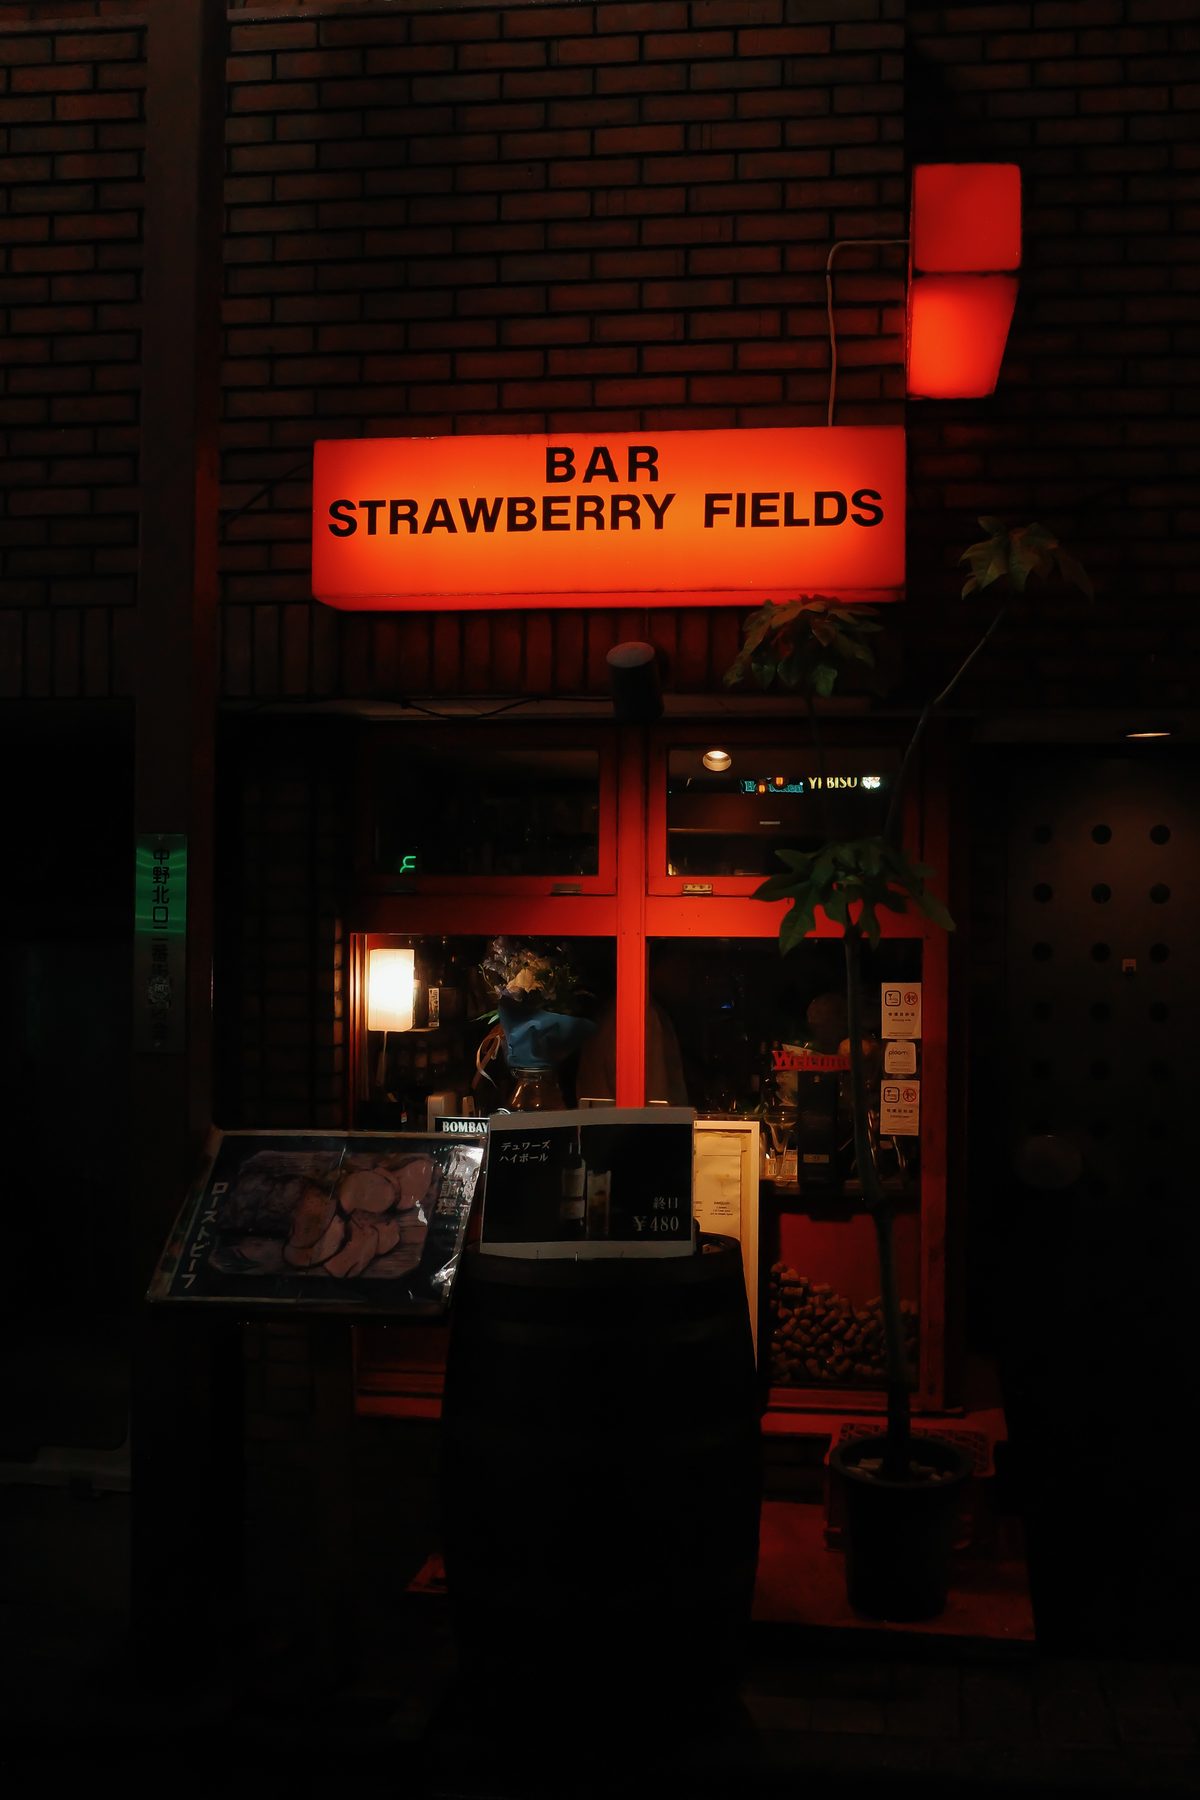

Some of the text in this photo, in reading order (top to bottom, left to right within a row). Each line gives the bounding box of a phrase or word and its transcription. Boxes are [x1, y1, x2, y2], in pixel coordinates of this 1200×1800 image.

[546, 446, 660, 484] BAR
[328, 489, 884, 537] STRAWBERRY FIELDS
[442, 1120, 488, 1133] BOMBAY
[499, 1152, 549, 1164] ハイボール
[181, 1182, 229, 1289] ローストビーフ
[632, 1215, 679, 1231] ¥480
